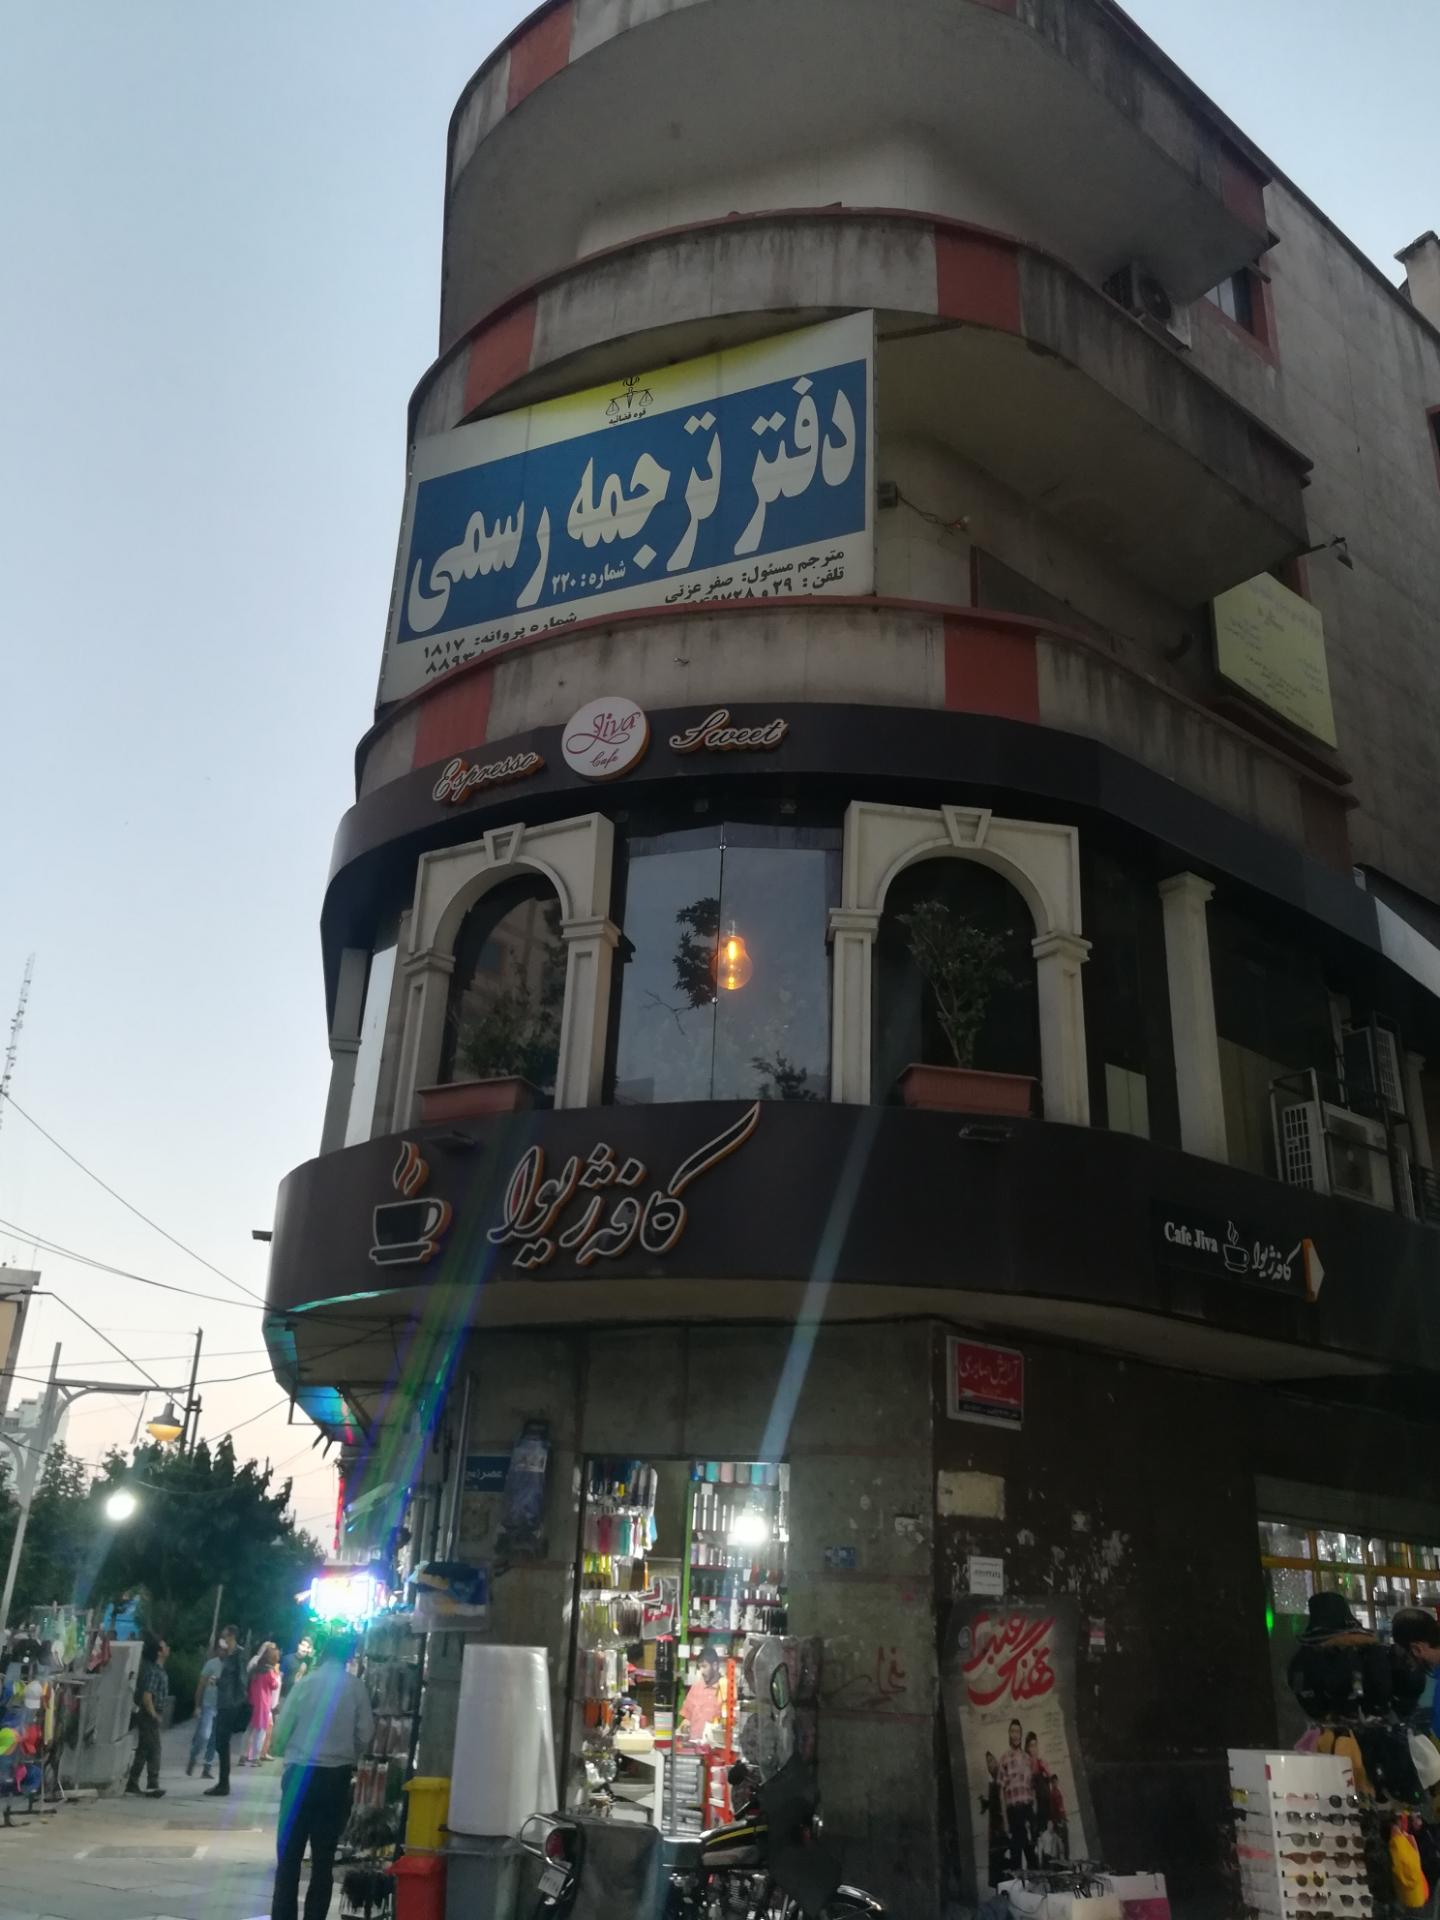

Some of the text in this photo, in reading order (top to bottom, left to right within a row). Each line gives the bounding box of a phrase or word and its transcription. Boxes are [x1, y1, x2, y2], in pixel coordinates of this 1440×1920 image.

[407, 375, 857, 634] دفتر ترجمه رسمی
[580, 560, 627, 590] شماره:
[742, 562, 794, 584] مسئول:
[798, 549, 845, 573] مترجم
[423, 637, 466, 659] ۱۸۱۷
[565, 711, 642, 755] Jiva
[669, 708, 788, 753] Sweet
[590, 750, 620, 769] Cafe
[432, 750, 541, 803] Espresso
[487, 1101, 761, 1268] کافه ژیوا
[1163, 1221, 1218, 1254] Cafe Jiva
